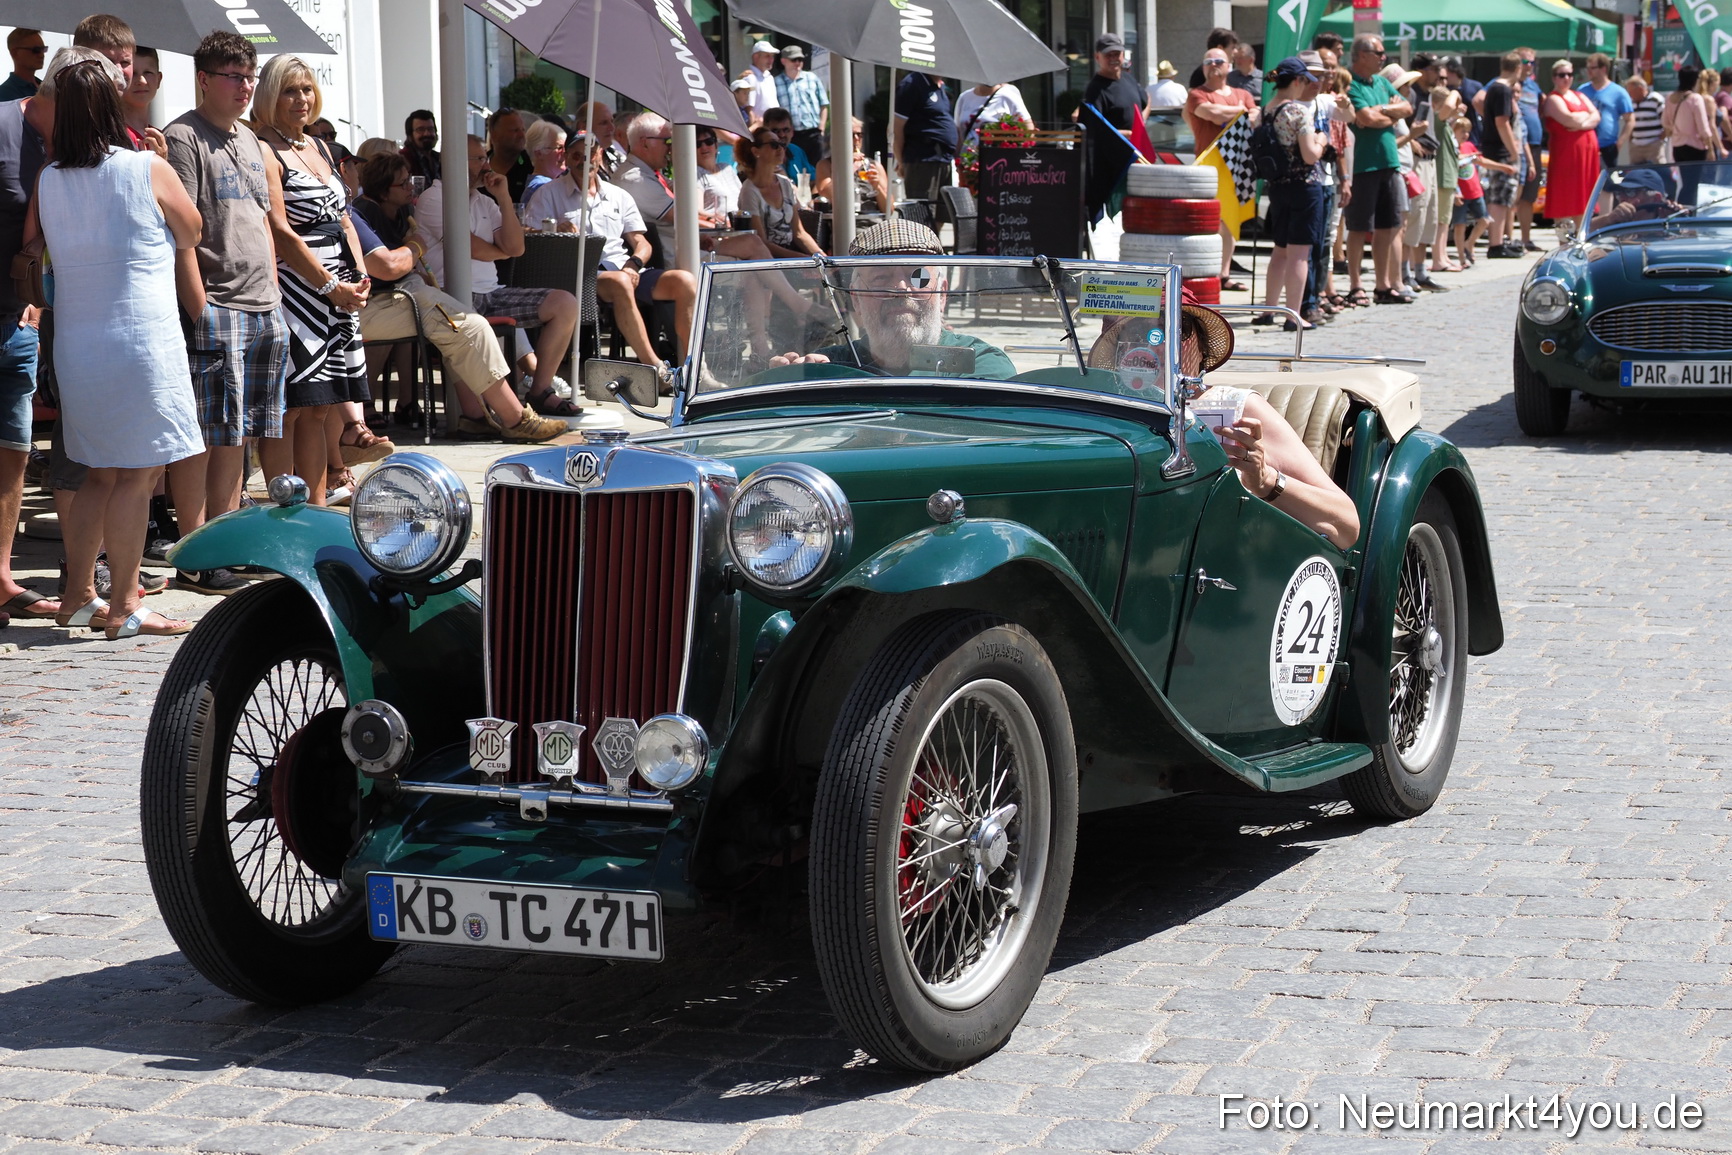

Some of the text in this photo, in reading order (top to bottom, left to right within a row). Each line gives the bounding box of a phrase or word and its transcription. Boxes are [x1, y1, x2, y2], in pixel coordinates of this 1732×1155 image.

[899, 1, 936, 62] now
[1423, 24, 1485, 41] DEKRA
[1146, 278, 1158, 288] 92
[1084, 299, 1125, 310] RIVERAIN
[1633, 365, 1732, 384] PAR AU 1H
[571, 454, 594, 478] MG
[1287, 595, 1331, 654] 24
[479, 732, 501, 757] MG
[546, 736, 569, 761] MG
[378, 913, 389, 928] D
[396, 884, 658, 952] KB TC 47H
